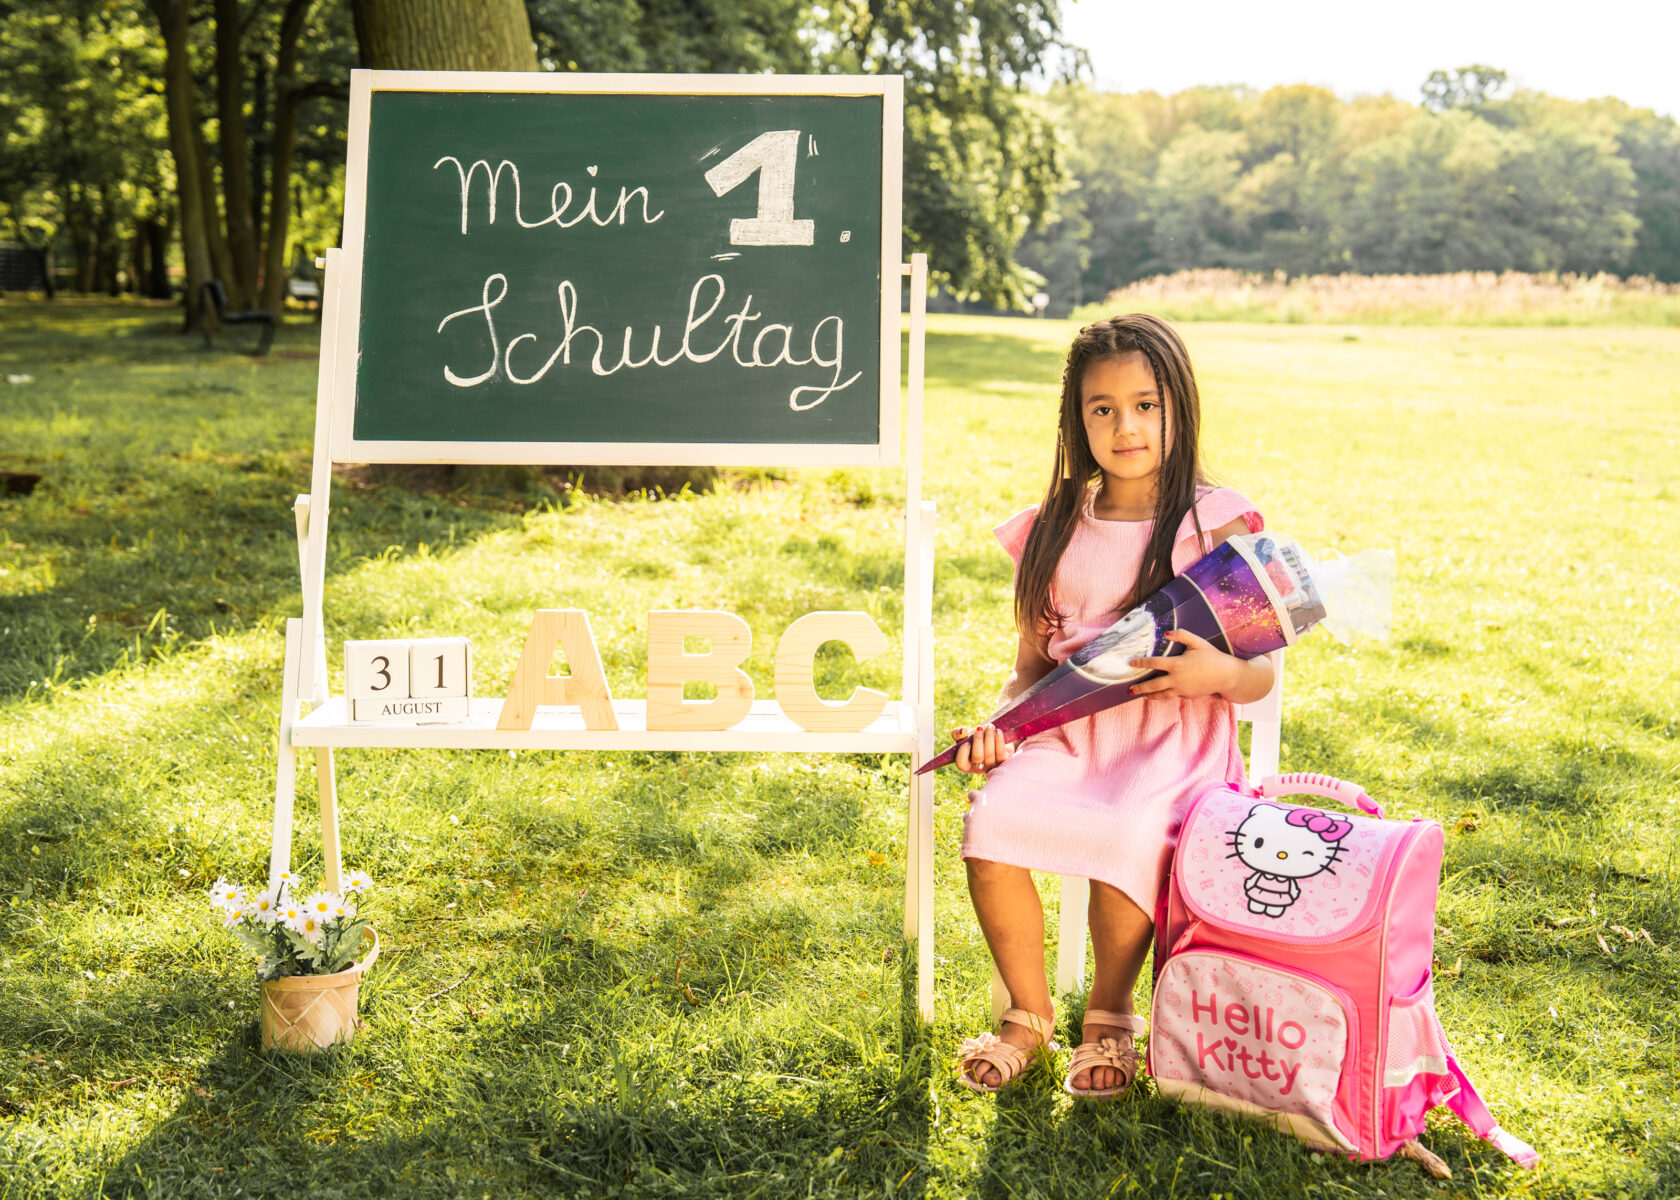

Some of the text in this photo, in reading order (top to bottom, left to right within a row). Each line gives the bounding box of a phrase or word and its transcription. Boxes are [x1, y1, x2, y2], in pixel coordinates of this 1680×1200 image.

[433, 155, 665, 235] Mein
[437, 272, 863, 412] Schultag
[381, 701, 443, 716] AUGUST
[1191, 989, 1307, 1050] Hello
[1196, 1031, 1303, 1096] Kitty
